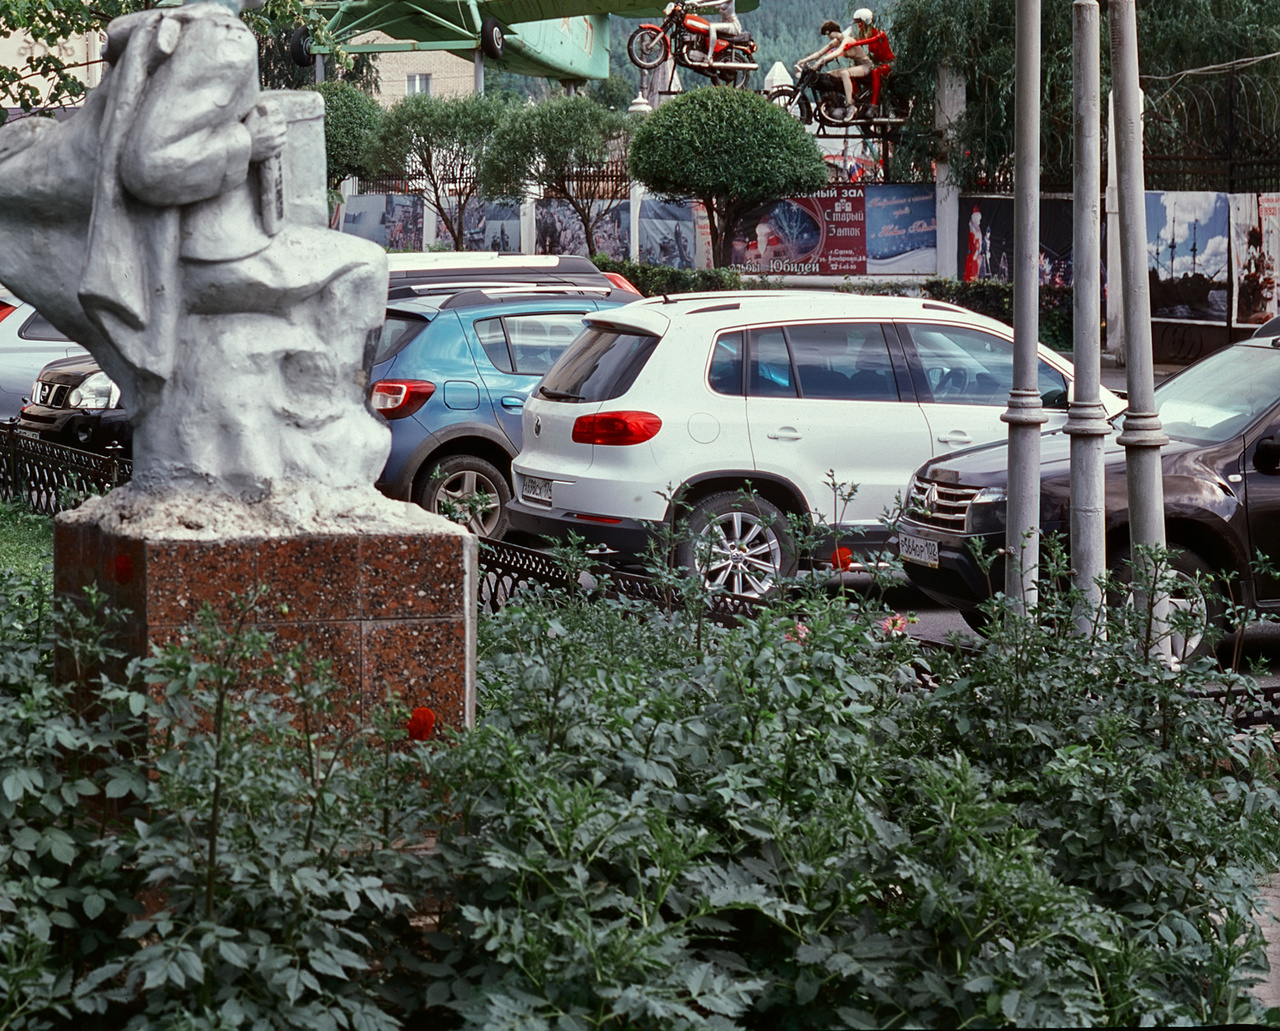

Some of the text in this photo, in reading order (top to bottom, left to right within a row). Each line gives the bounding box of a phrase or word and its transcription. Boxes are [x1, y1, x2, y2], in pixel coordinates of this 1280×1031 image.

[841, 189, 864, 198] зал
[824, 209, 864, 222] Старый
[828, 224, 861, 237] Замок
